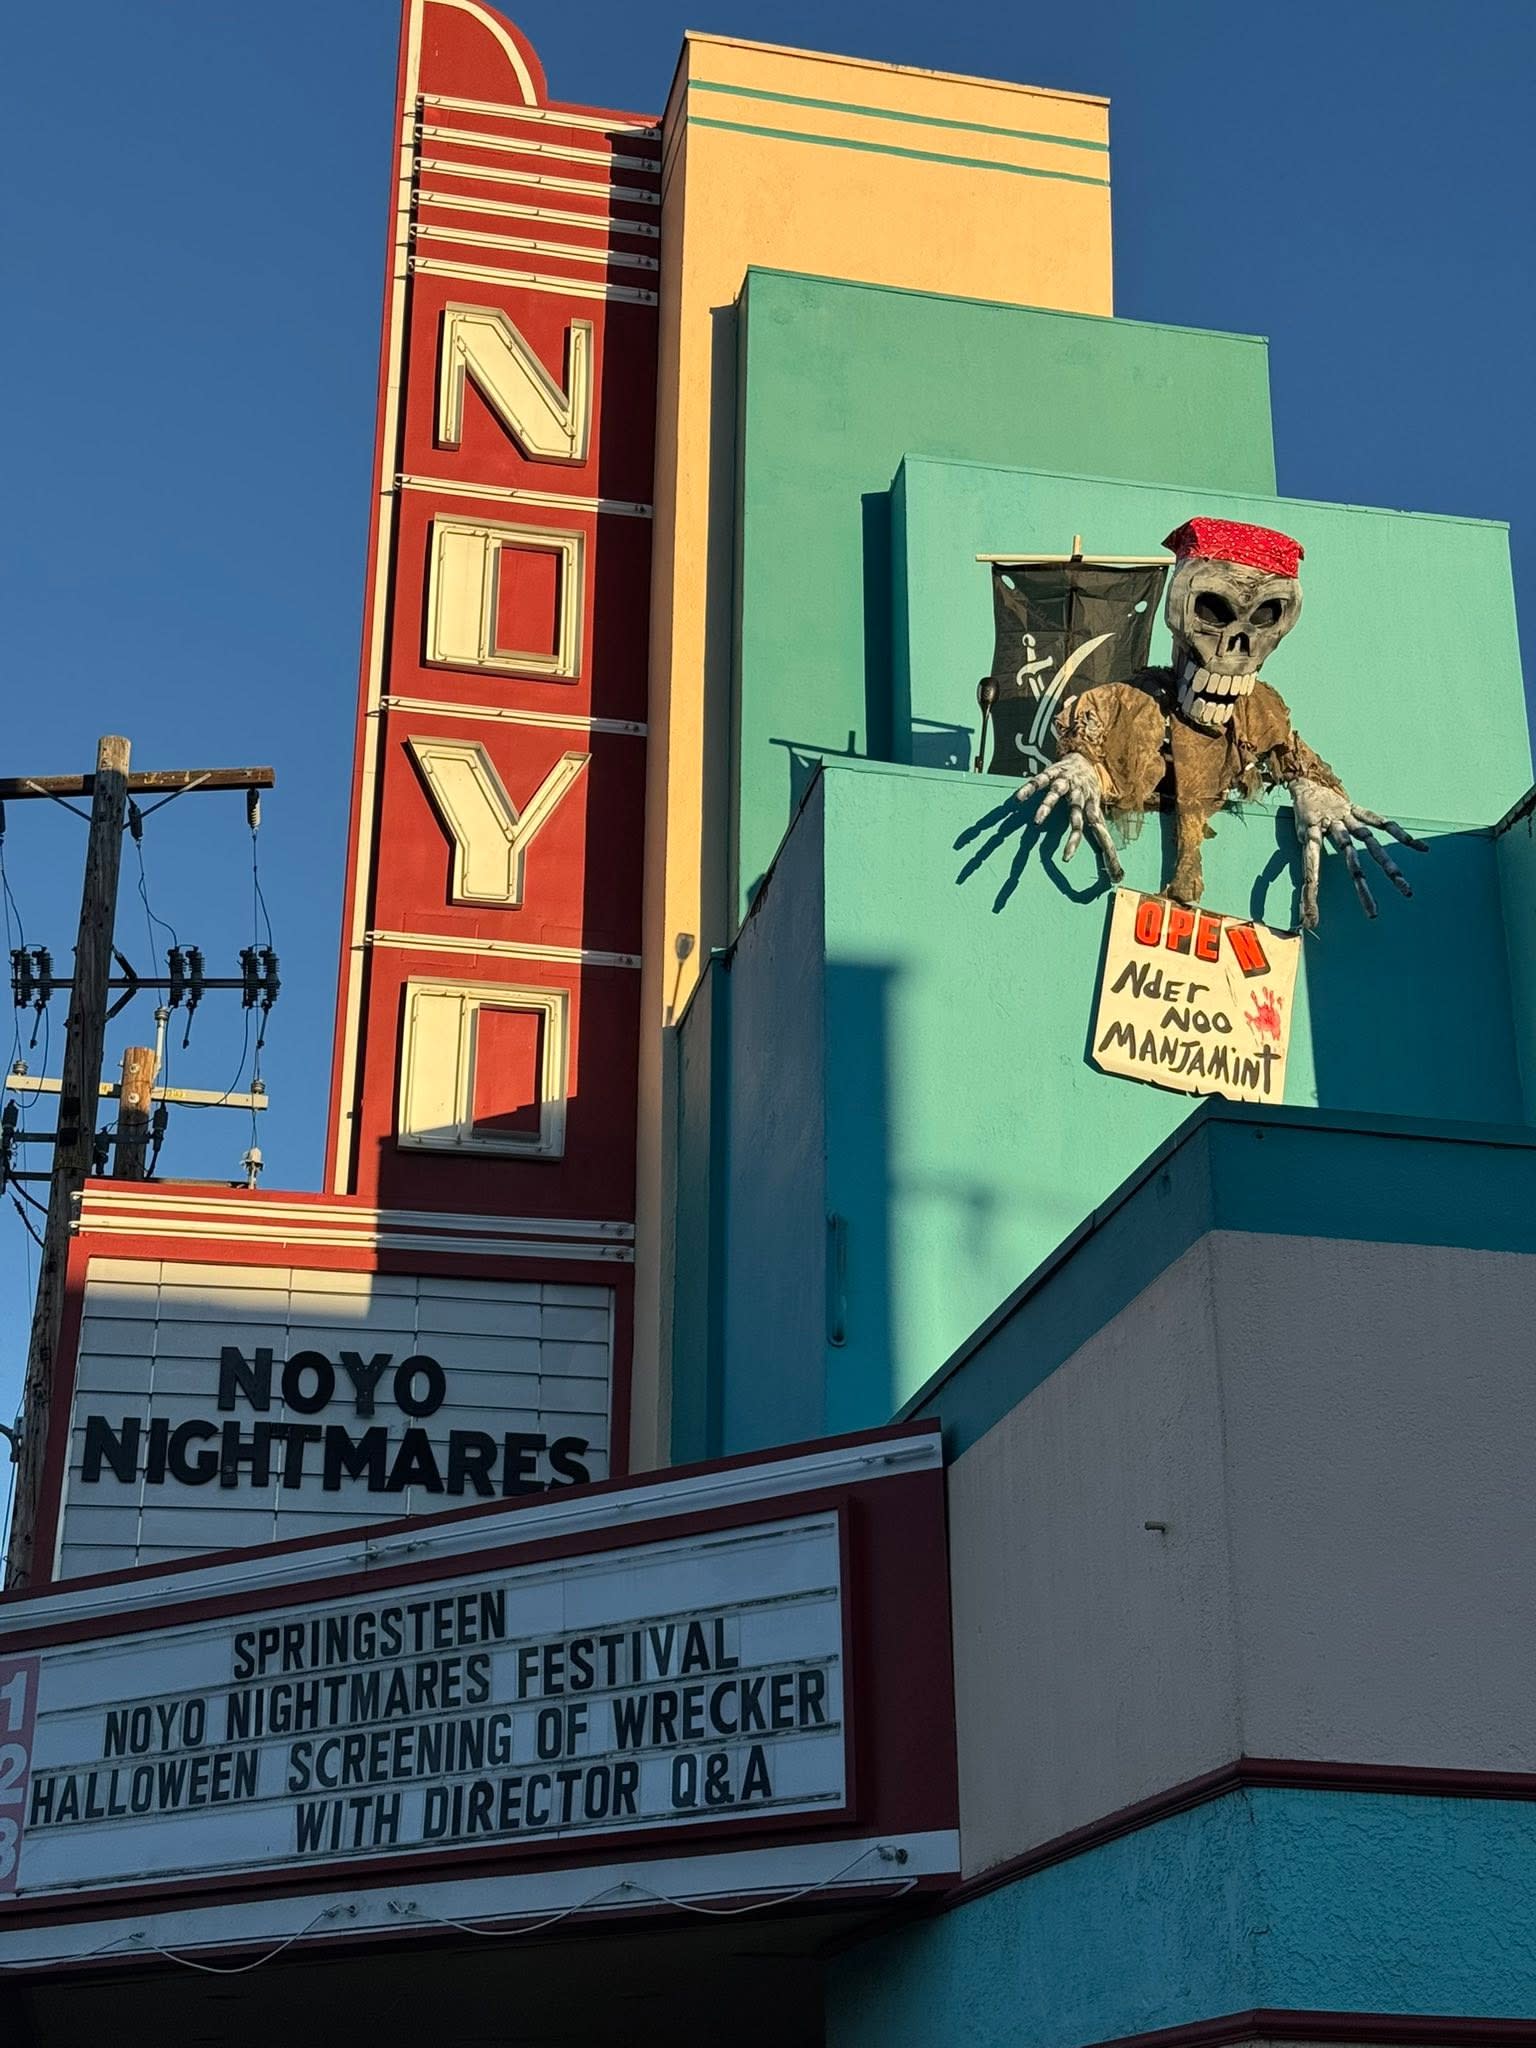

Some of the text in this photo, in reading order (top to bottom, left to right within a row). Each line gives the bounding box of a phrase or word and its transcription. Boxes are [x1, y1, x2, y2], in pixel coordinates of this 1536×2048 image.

[396, 301, 594, 1160] NOYO
[1134, 897, 1271, 979] OPEN
[1160, 1006, 1233, 1034] NOO
[217, 1346, 447, 1418] NOYO
[81, 1415, 591, 1497] NIGHTMARES
[233, 1589, 505, 1680] SPRINGSTEEN
[0, 1670, 28, 1732] 1
[103, 1617, 739, 1758] NOYO NIGHTMARES FESTIVAL
[0, 1732, 27, 1804] 2
[30, 1669, 825, 1826] HALLOWEEN SCREENING OF WRECKER
[296, 1745, 772, 1853] WITH DIRECTOR Q&A
